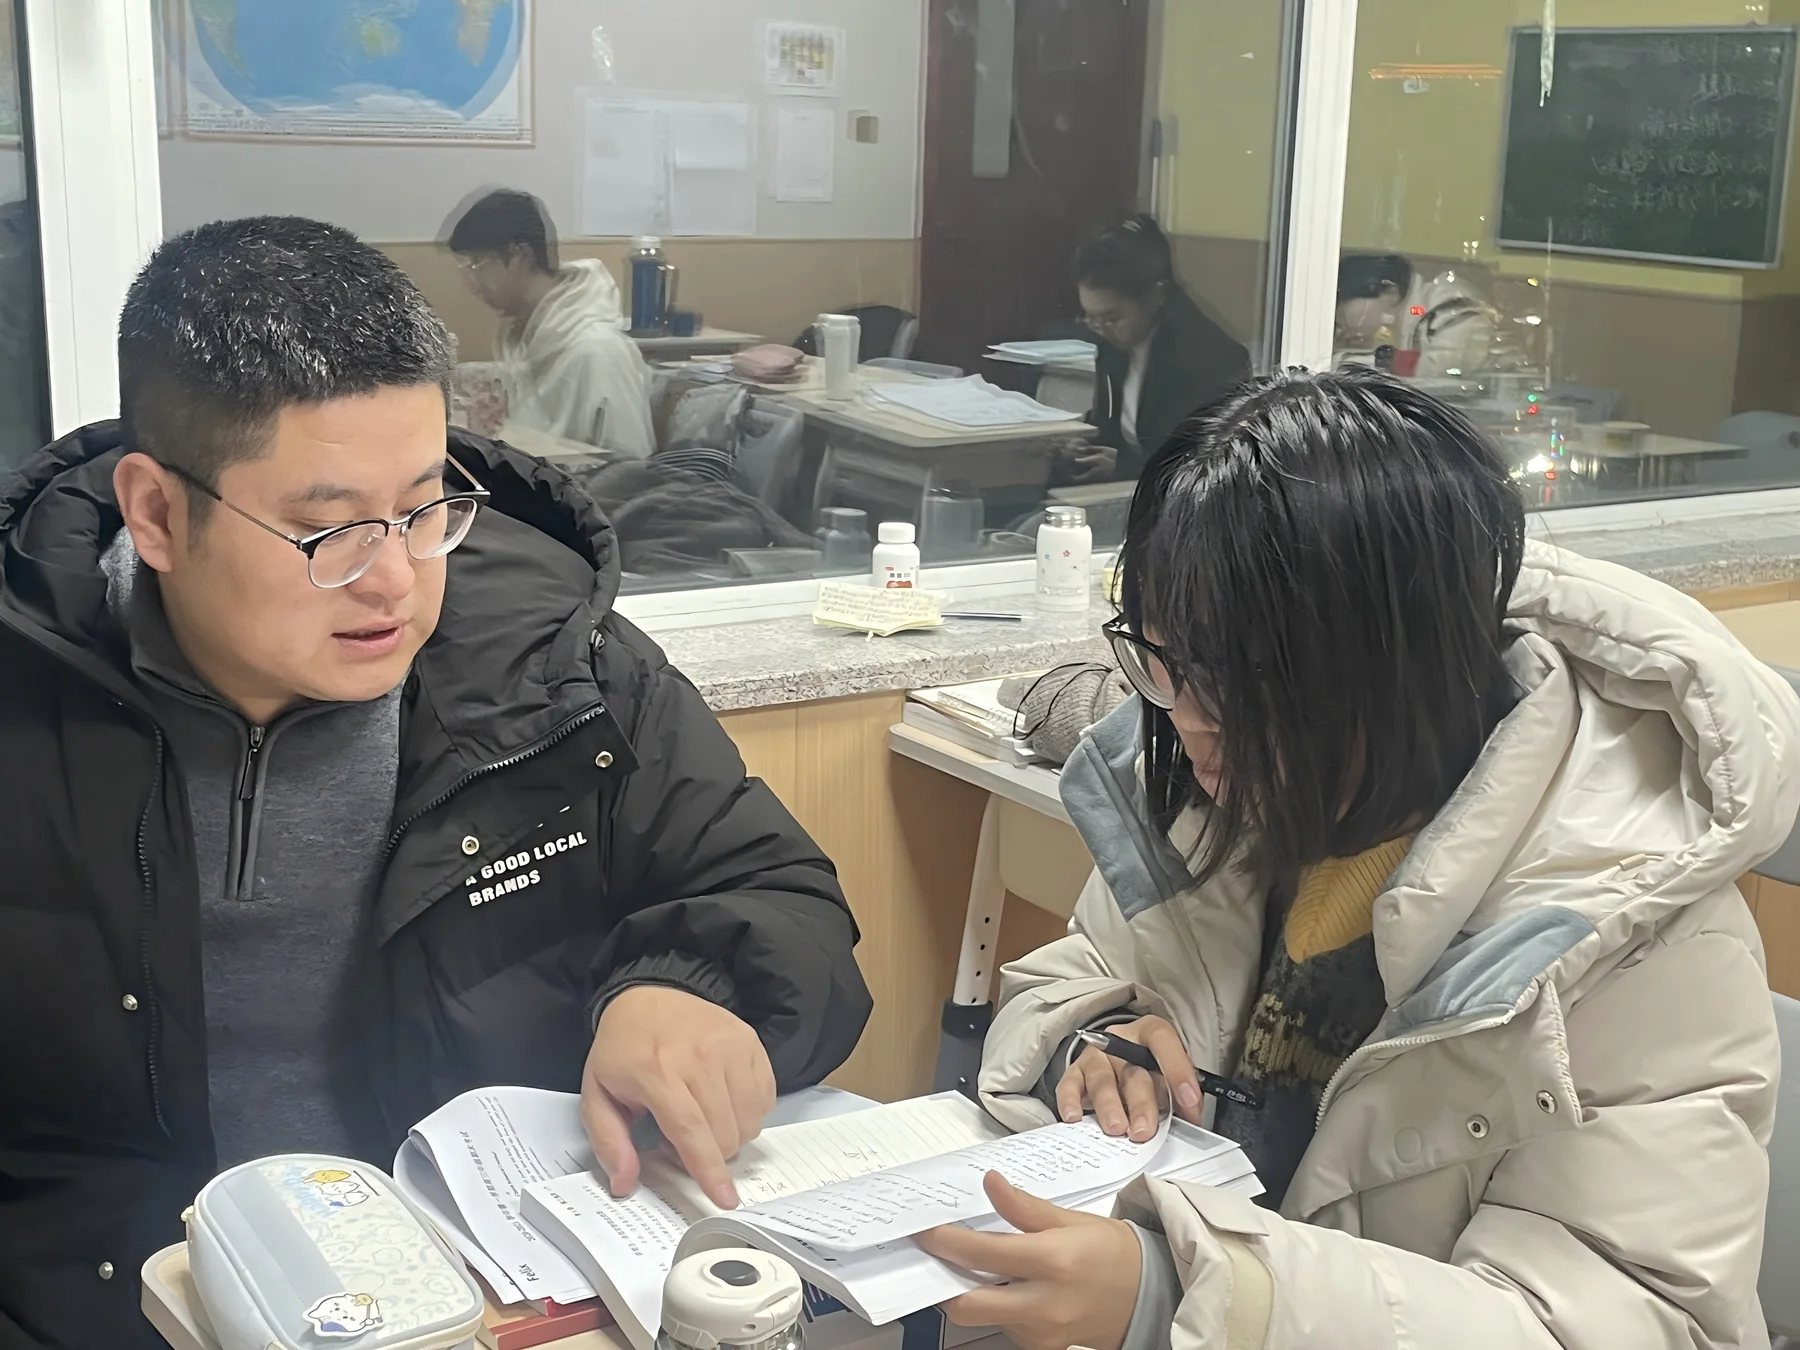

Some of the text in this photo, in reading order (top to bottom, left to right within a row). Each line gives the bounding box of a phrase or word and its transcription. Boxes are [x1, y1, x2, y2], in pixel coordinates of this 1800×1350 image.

[480, 851, 531, 879] GOOD
[533, 831, 588, 860] LOCAL
[468, 869, 541, 907] BRANDS
[519, 1263, 540, 1282] Felix
